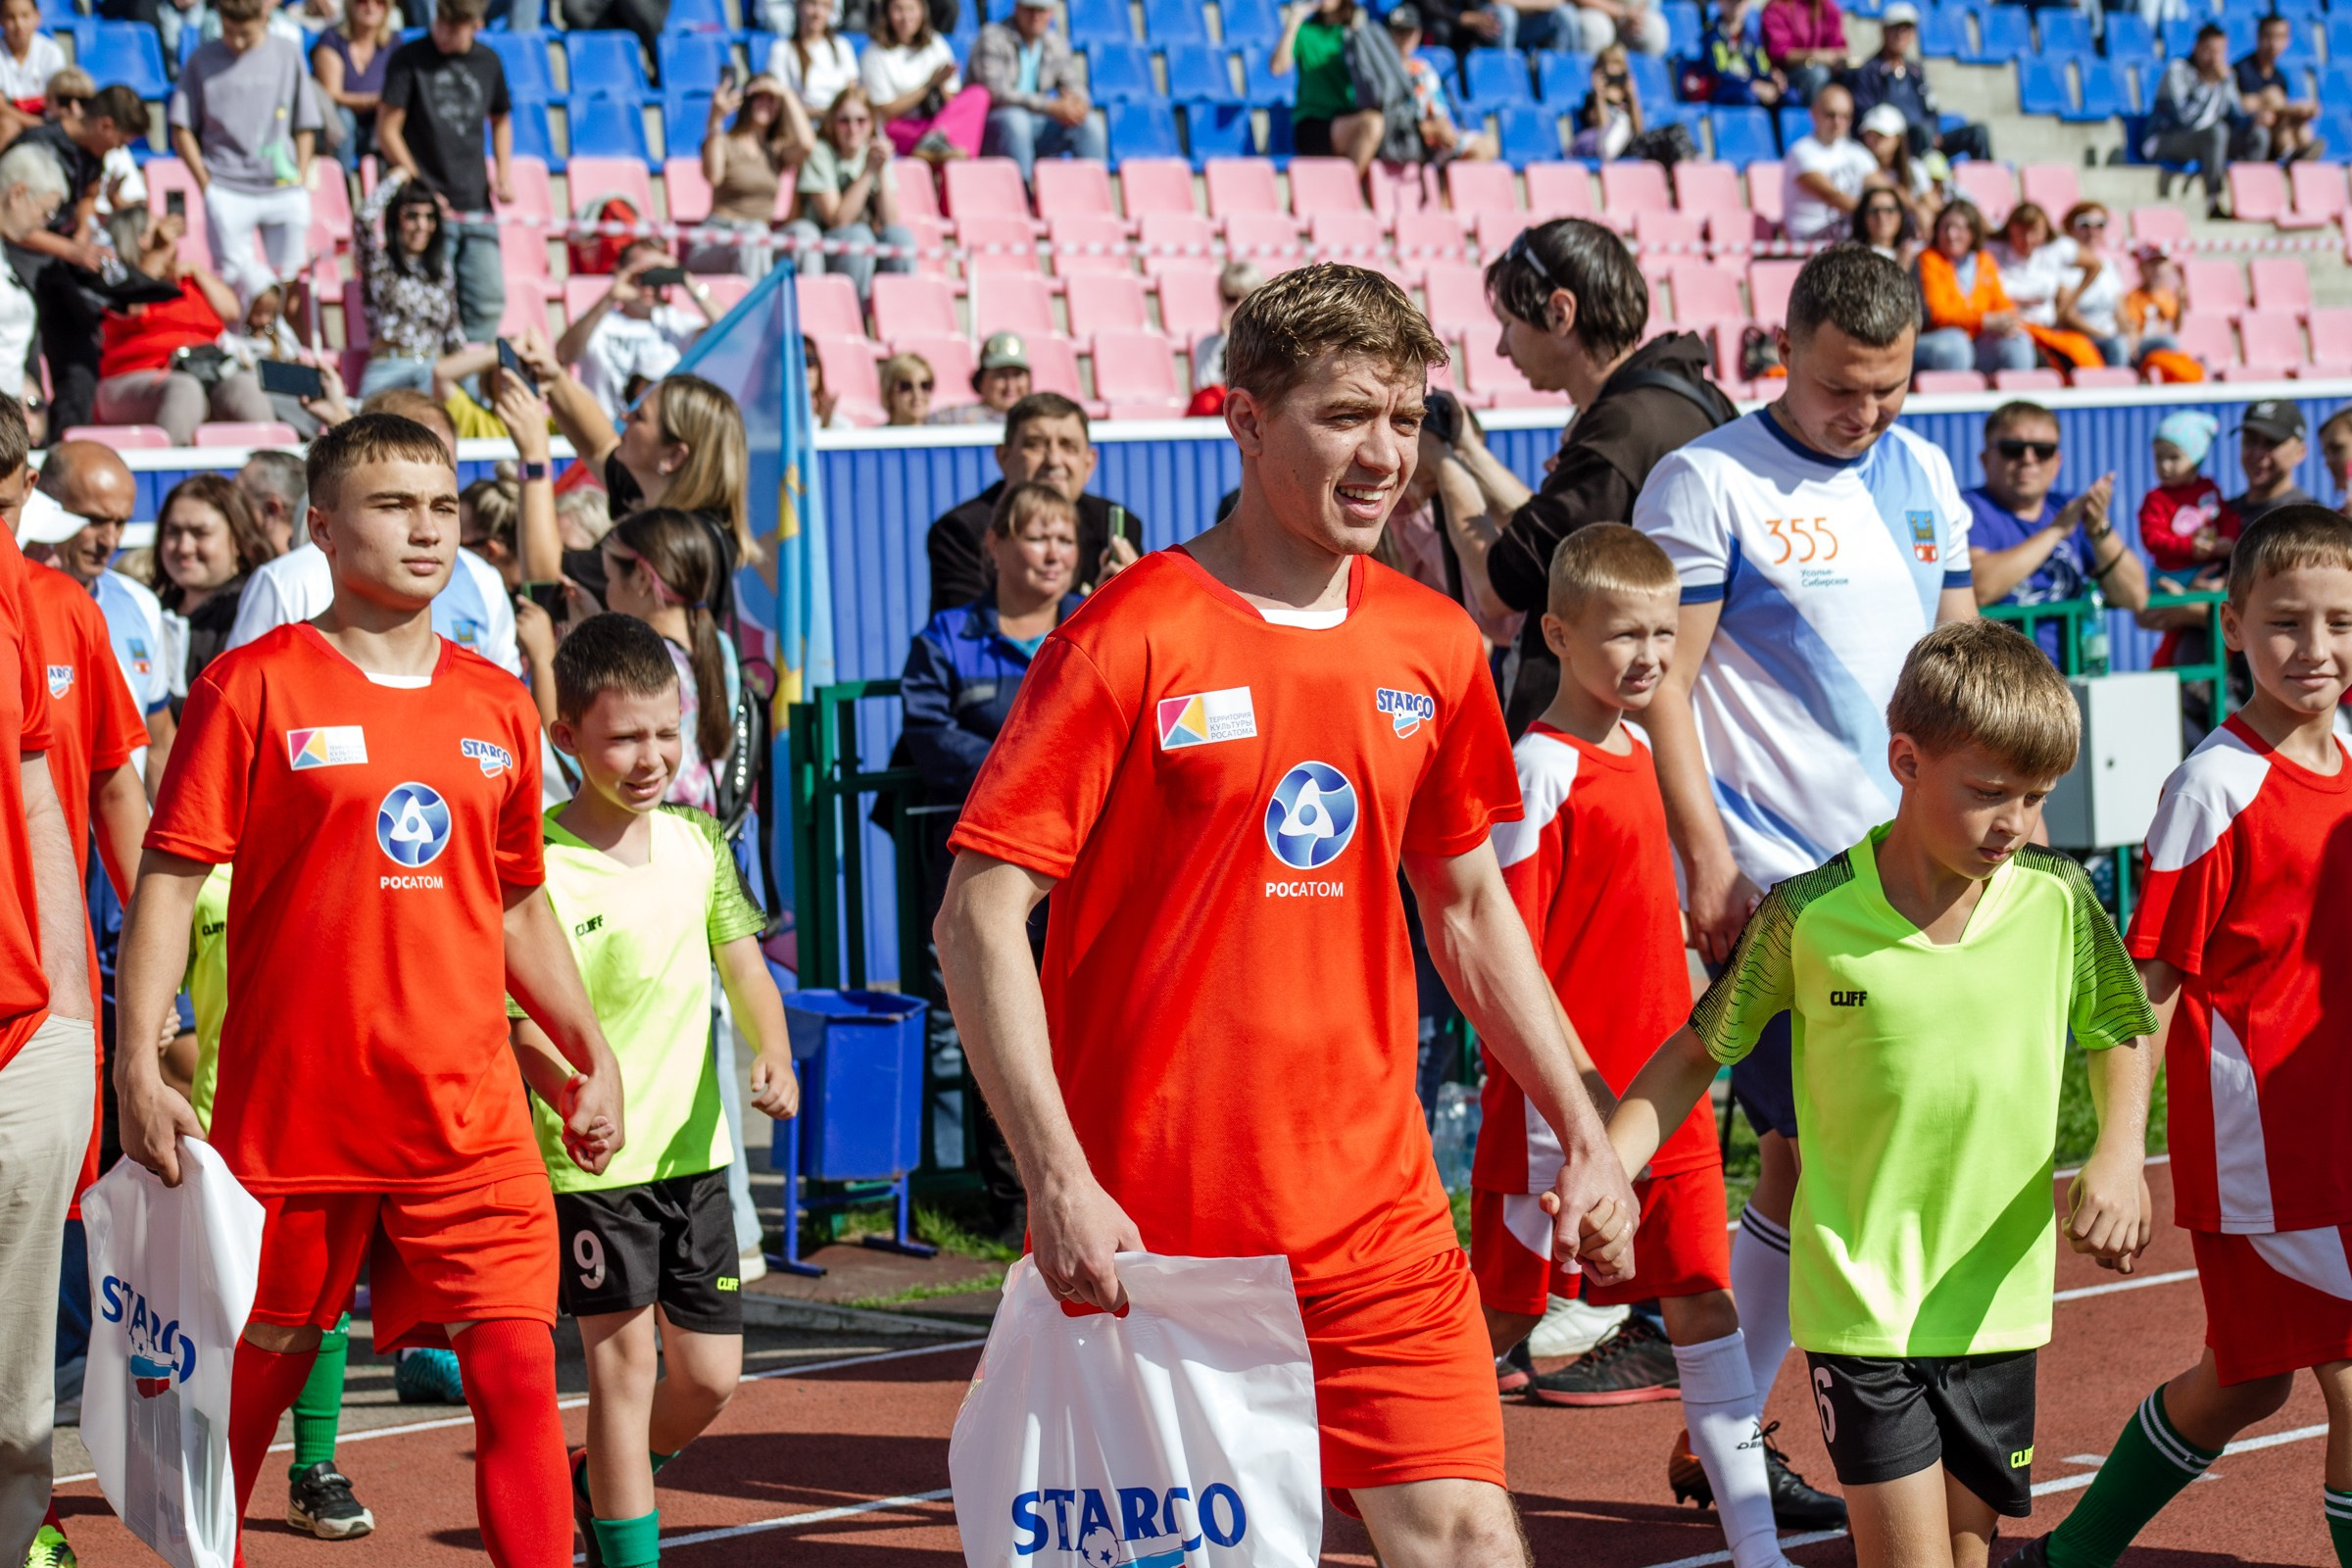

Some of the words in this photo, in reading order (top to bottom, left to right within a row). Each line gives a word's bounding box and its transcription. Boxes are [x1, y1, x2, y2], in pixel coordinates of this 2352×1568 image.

[1766, 516, 1838, 564] 355
[1801, 577, 1848, 588] Сибирское
[1377, 689, 1434, 718] STARCO
[1209, 711, 1252, 724] ТЕРРИТОРИЯ
[1209, 719, 1253, 732] КУЛЬТУРЫ
[1211, 727, 1254, 740] РОСАТОМА
[462, 740, 512, 767] STARCO
[380, 876, 444, 890] РОСАТОМ
[1265, 882, 1344, 898] РОСАТОМ
[575, 914, 603, 937] CLIFF
[1831, 991, 1868, 1006] CLIFF
[573, 1229, 606, 1290] 9
[716, 1277, 740, 1291] CLIFF
[1813, 1366, 1837, 1444] 6
[2011, 1445, 2034, 1469] CLIF
[1011, 1482, 1248, 1556] STARCO
